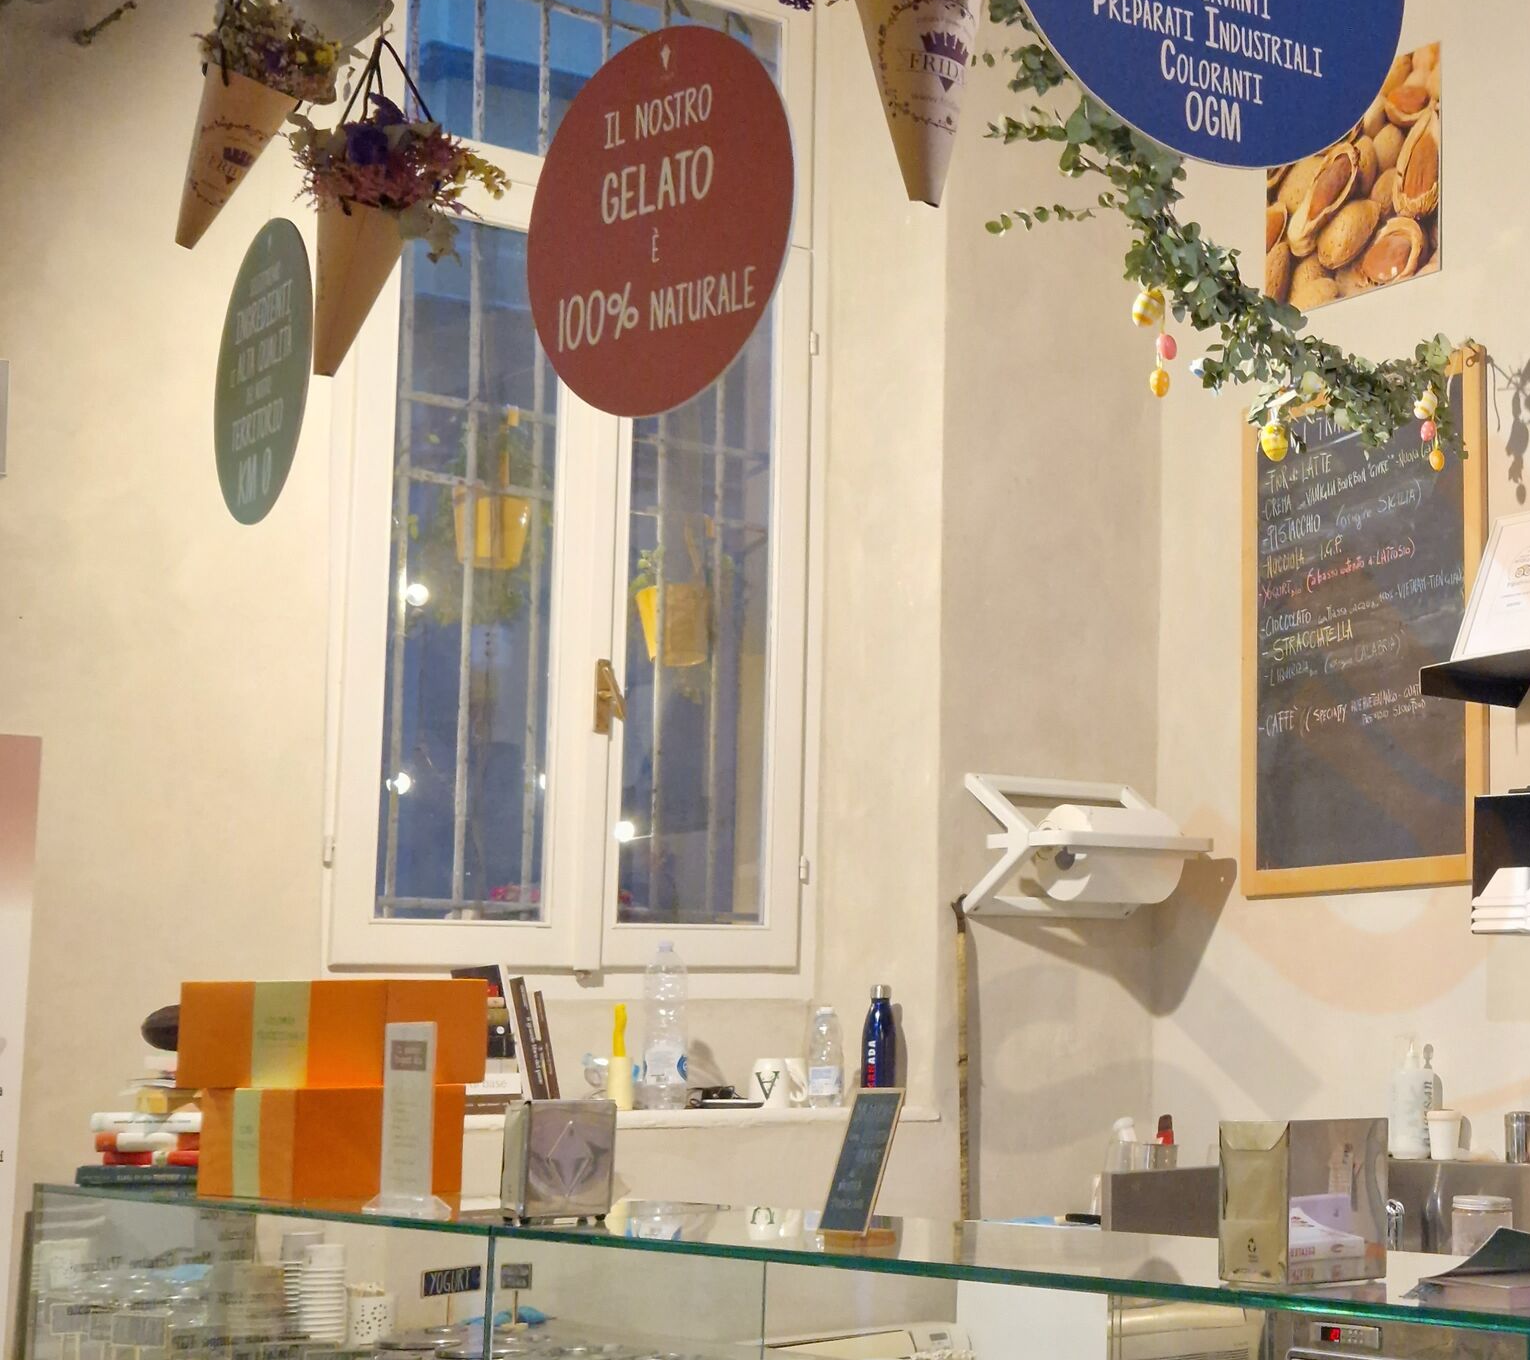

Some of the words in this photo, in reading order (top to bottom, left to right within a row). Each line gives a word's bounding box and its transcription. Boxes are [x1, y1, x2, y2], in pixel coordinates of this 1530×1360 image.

[1160, 40, 1263, 104] COLORANTI
[1205, 6, 1322, 78] INDUSTRIALI
[604, 111, 625, 149] IL
[636, 83, 713, 140] NOSTRO
[1185, 91, 1241, 142] OGM
[601, 145, 715, 225] GELATO
[651, 227, 660, 263] È
[559, 282, 639, 353] 100%
[650, 265, 757, 331] NATURALE
[428, 1266, 473, 1295] YOGURT
